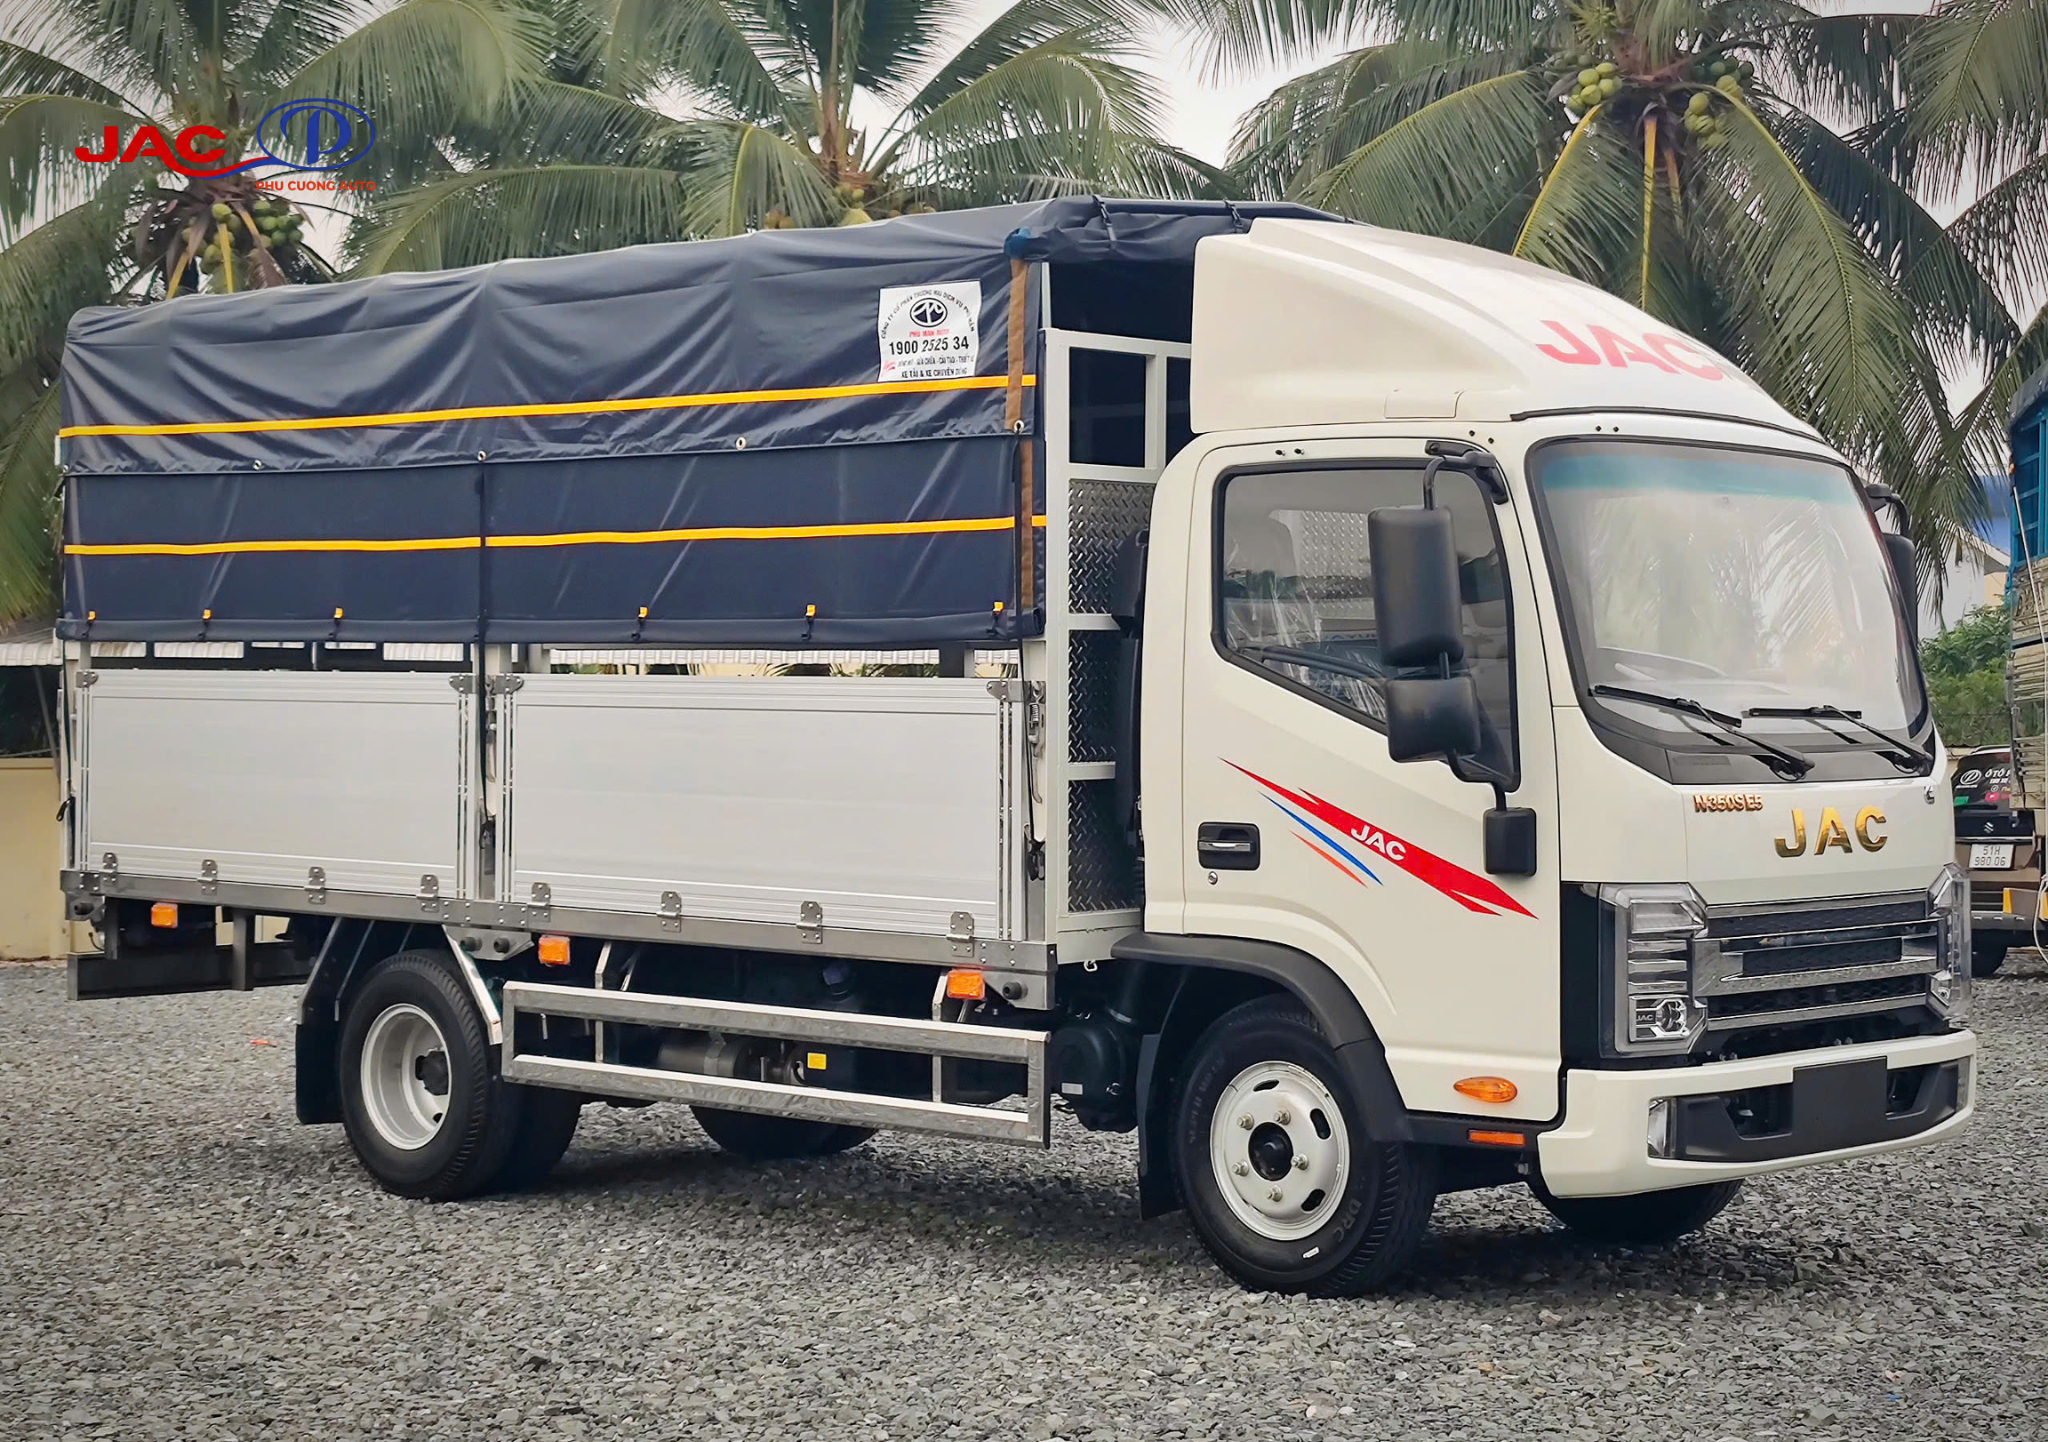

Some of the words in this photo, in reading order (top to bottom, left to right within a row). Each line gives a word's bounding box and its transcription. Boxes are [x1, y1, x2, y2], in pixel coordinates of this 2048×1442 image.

[889, 340, 918, 355] 1900
[921, 337, 949, 353] 2525
[953, 336, 969, 350] 34
[1535, 320, 1723, 381] JAC
[1350, 824, 1406, 861] JAC
[1774, 805, 1888, 858] JAC
[1983, 846, 2000, 856] 51H
